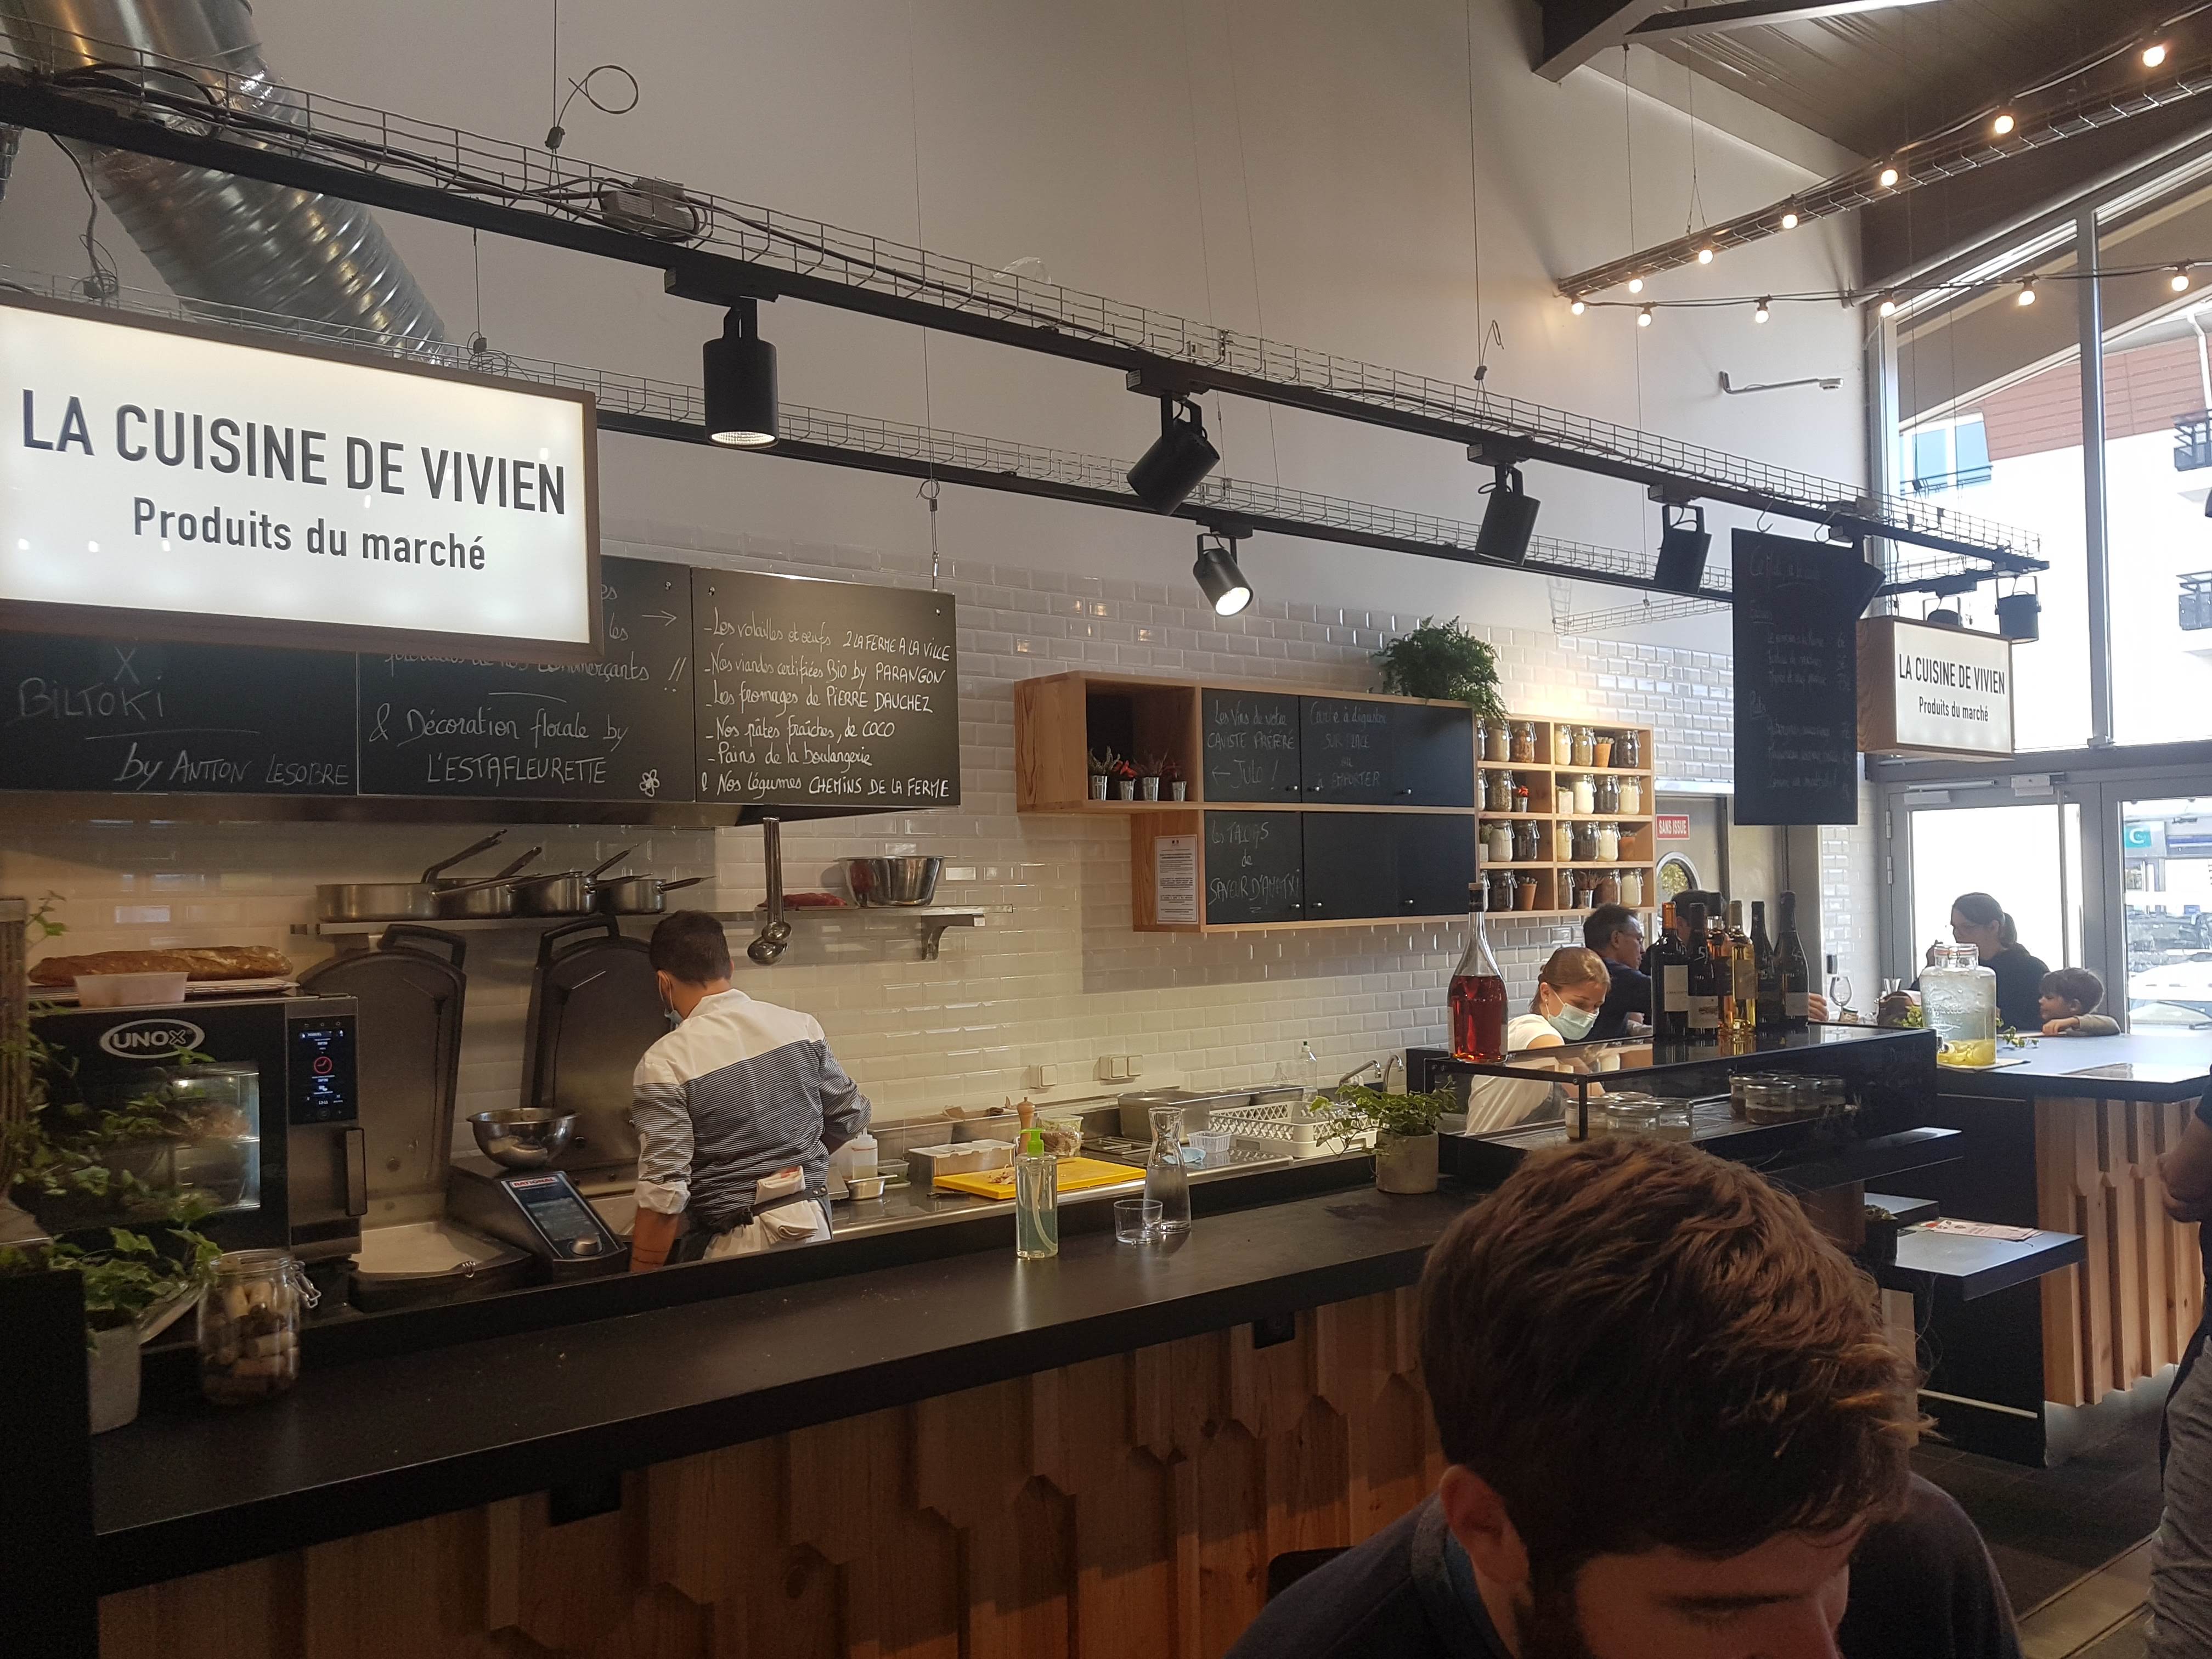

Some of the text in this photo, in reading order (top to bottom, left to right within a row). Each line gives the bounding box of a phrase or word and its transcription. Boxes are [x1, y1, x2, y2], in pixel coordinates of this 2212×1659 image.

[22, 389, 566, 516] LA CUISINE DE VIVIEN
[134, 496, 487, 572] Produits du marché
[738, 610, 783, 641] volailles
[788, 622, 800, 642] et
[866, 634, 896, 653] FERME
[909, 640, 919, 656] LA
[736, 652, 774, 674] viandes
[777, 655, 823, 685] certifiées
[851, 659, 867, 690] by
[876, 662, 946, 684] PARANGON
[1899, 653, 2005, 695] LA CUISINE DE VIVIEN
[739, 681, 798, 718] fromages
[806, 685, 821, 706] de
[874, 692, 933, 713] DAUCHEZ
[1919, 696, 1988, 722] Produits du marché
[397, 706, 520, 747] Décoration
[531, 708, 589, 748] florale
[603, 714, 629, 752] by
[744, 718, 780, 747] pâtes
[845, 716, 857, 737] de
[113, 742, 163, 791] by
[266, 754, 348, 786] LESOBRE
[765, 743, 782, 765] de
[786, 742, 799, 764] la
[716, 771, 742, 797] Nos
[868, 778, 887, 796] DE
[891, 777, 902, 794] LA
[908, 777, 950, 798] FERME
[1658, 820, 1686, 834] SANS ISSUE
[114, 1029, 187, 1048] UNOX
[514, 1177, 554, 1186] RATIONAL
